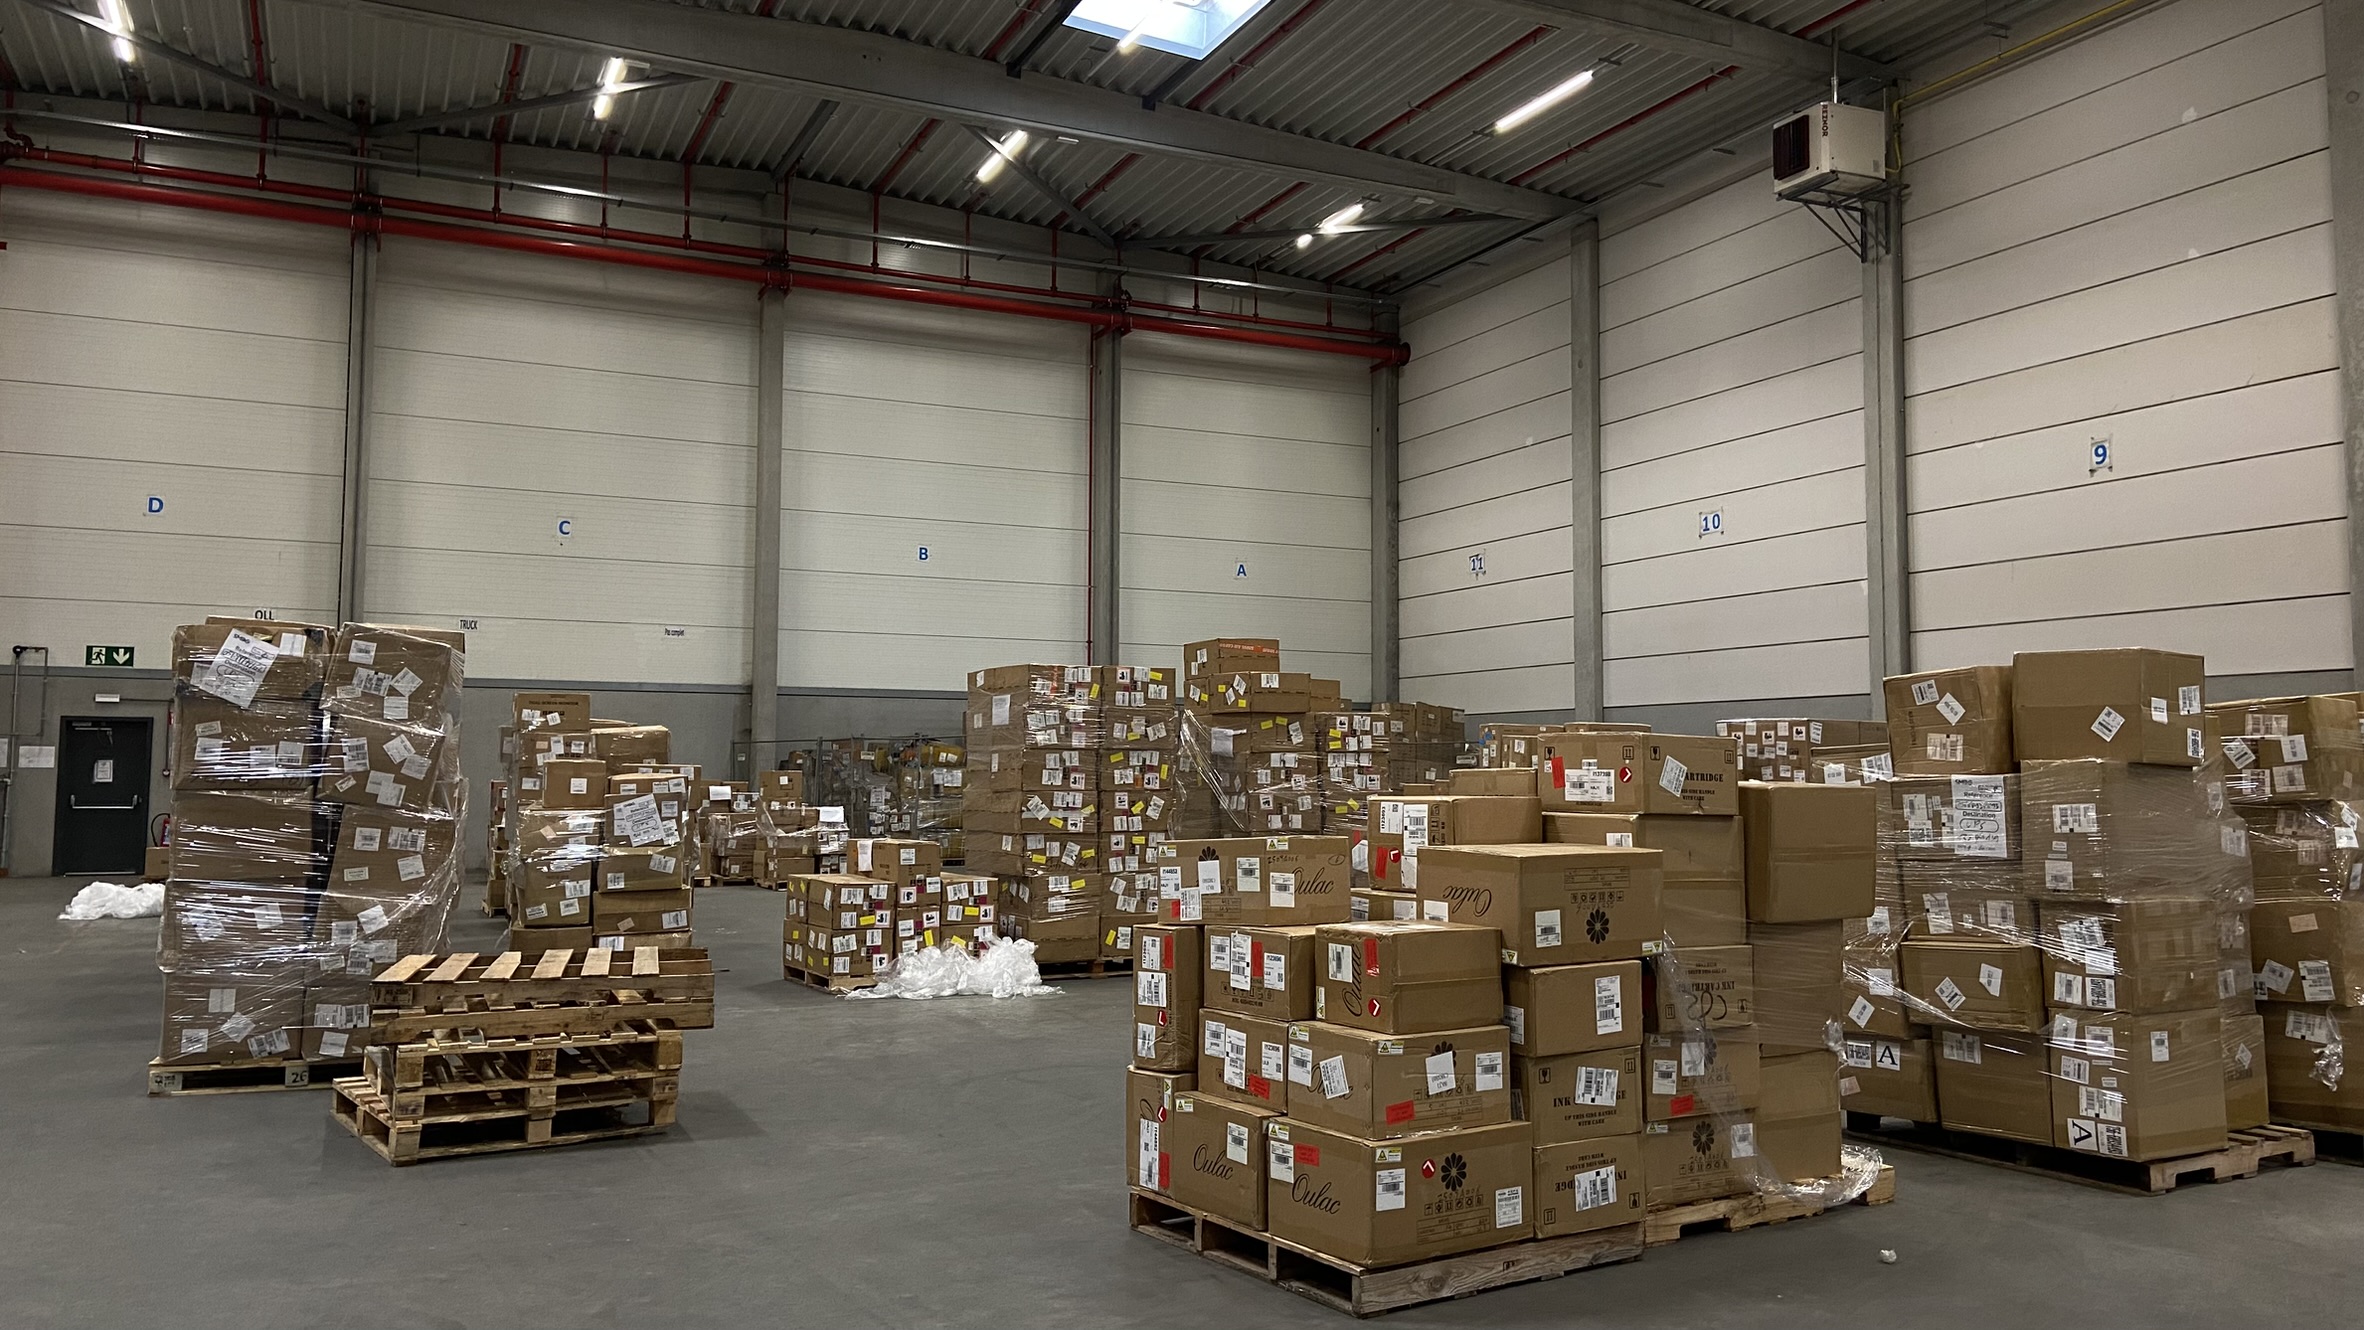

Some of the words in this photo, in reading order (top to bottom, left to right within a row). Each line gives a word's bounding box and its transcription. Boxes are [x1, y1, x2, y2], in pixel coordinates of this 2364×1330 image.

[1821, 104, 1829, 137] REZNOR
[2094, 443, 2108, 466] 9
[147, 497, 164, 514] D
[558, 520, 572, 536] C
[1701, 513, 1722, 532] 10
[919, 547, 929, 561] B
[1236, 563, 1247, 577] A
[1469, 556, 1485, 572] 11
[459, 619, 478, 631] TRUCK
[1684, 772, 1724, 783] ARTRIDGE
[1442, 886, 1492, 917] Oulac
[1721, 981, 1735, 990] INK
[1877, 1045, 1898, 1066] A
[292, 1070, 307, 1083] 26
[1553, 1096, 1571, 1108] INK
[2071, 1120, 2093, 1146] A
[1193, 1144, 1234, 1181] Oulac
[1291, 1173, 1342, 1215] Oulac
